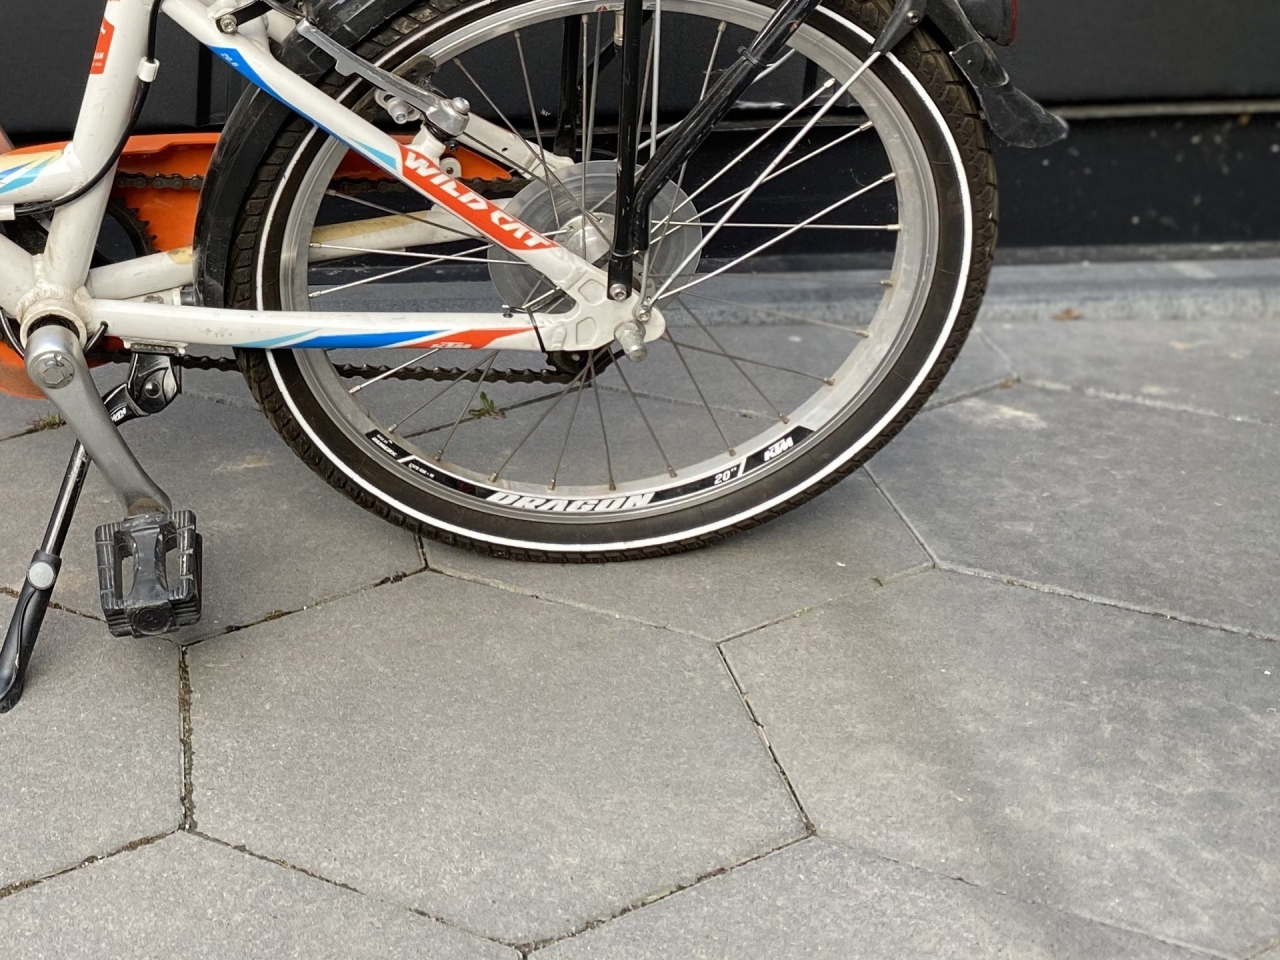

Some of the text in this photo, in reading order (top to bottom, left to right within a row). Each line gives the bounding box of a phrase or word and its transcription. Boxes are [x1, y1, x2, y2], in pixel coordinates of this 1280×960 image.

[404, 151, 552, 248] WILD CAT
[485, 436, 794, 513] DRAGON 20" KTM
